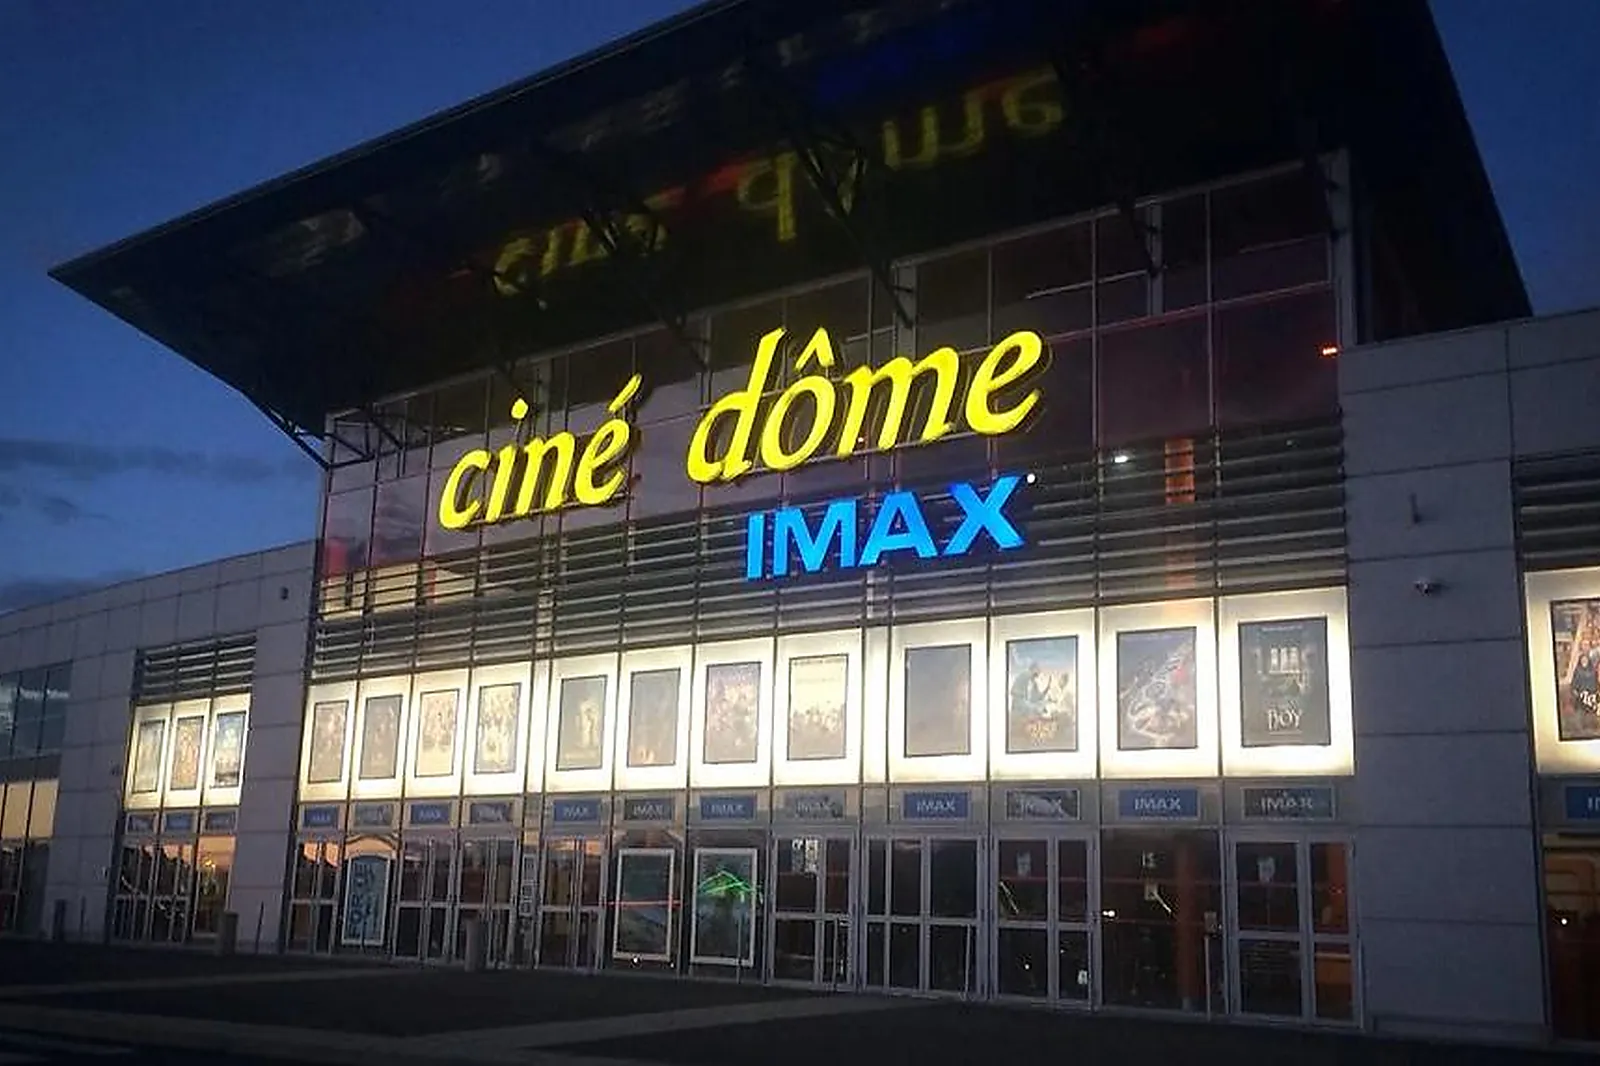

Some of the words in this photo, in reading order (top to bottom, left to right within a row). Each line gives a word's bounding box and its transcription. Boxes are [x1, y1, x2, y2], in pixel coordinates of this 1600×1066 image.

[440, 373, 643, 530] ciné
[687, 326, 1046, 485] dôme
[746, 473, 1025, 580] IMAX
[711, 803, 745, 816] IMAX
[916, 797, 956, 812] IMAX
[1132, 797, 1180, 810] IMAX
[1259, 797, 1312, 812] IMAX
